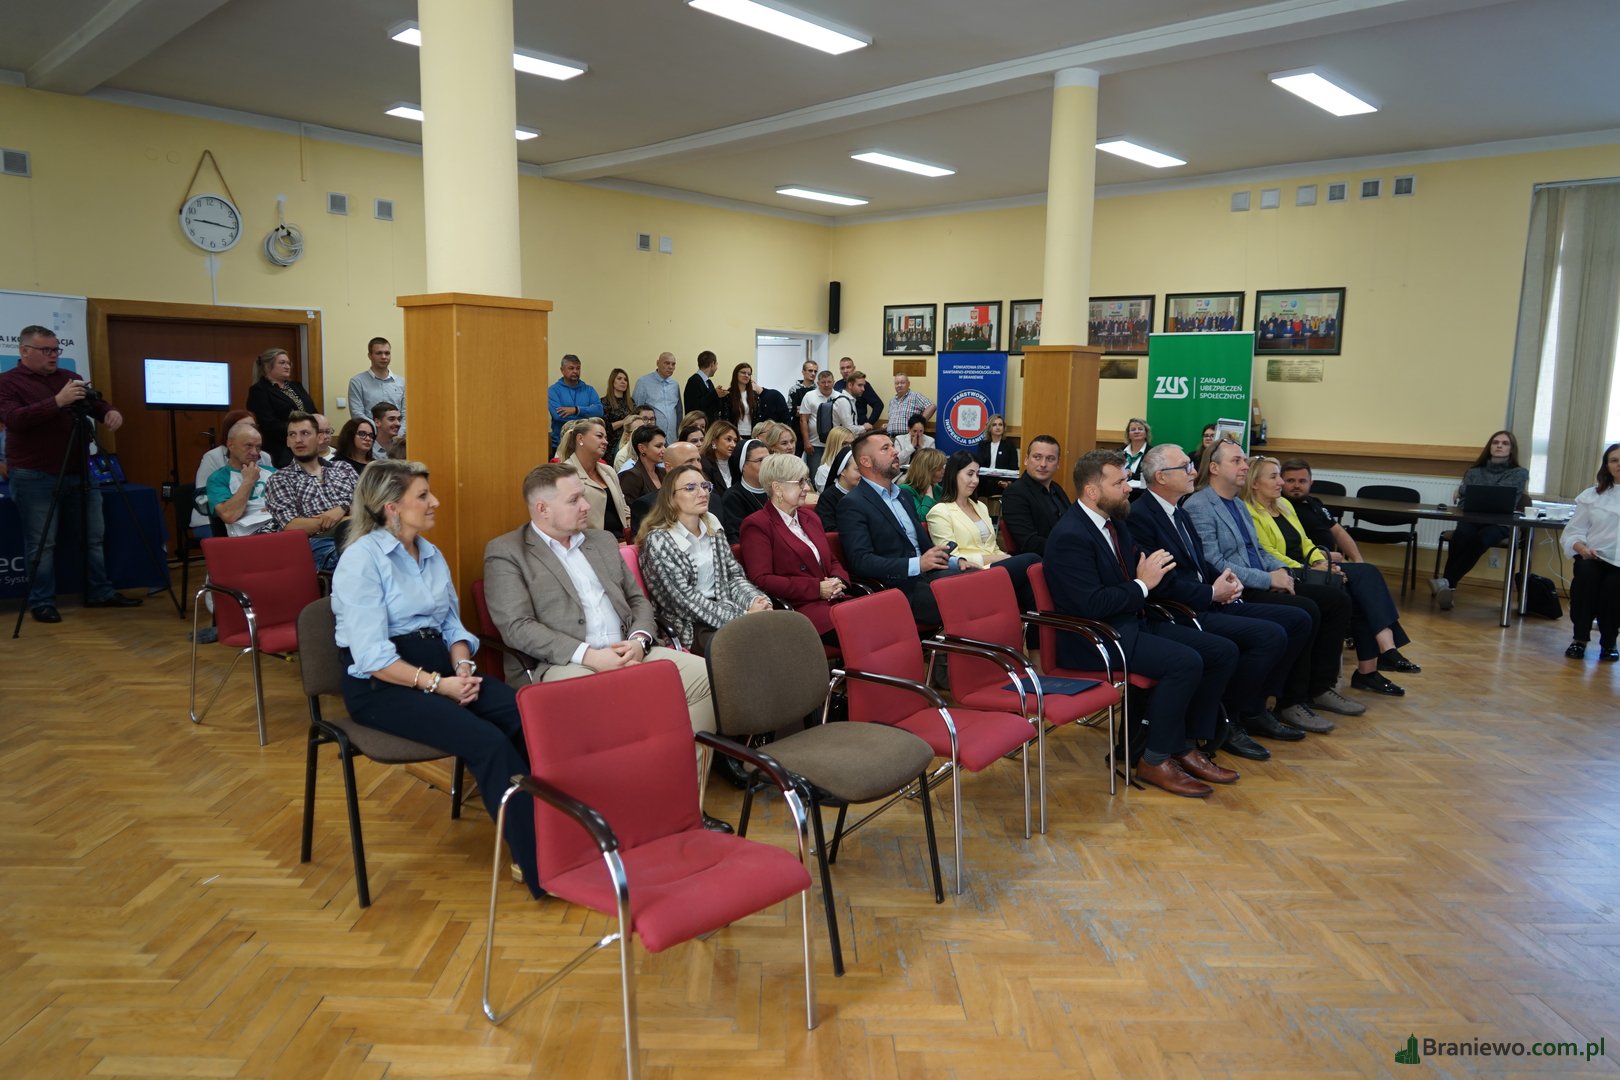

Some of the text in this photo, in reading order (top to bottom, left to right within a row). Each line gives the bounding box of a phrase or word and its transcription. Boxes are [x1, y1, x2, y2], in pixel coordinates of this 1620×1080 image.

[188, 206, 196, 215] 10
[1153, 376, 1189, 399] ZUS
[945, 418, 967, 444] INSPEKCJA
